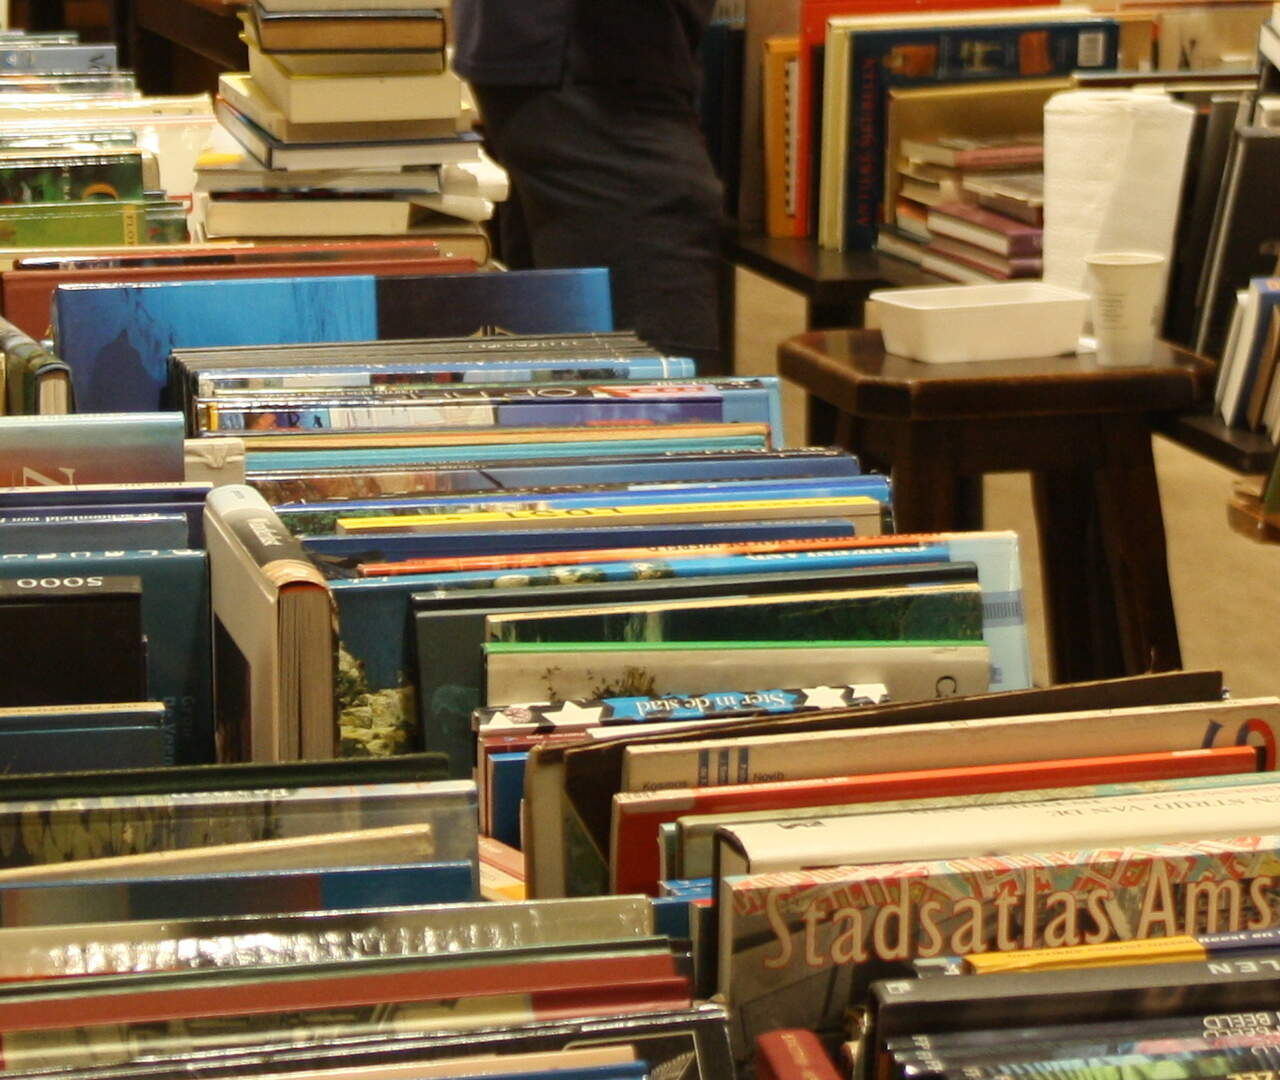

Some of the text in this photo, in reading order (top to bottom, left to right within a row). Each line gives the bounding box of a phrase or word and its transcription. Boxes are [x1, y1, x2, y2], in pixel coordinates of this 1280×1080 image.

[16, 576, 104, 589] 5000
[635, 692, 786, 716] Ster in de stad
[1090, 805, 1145, 816] VAN
[763, 865, 1115, 969] Stadsatlas
[1252, 930, 1274, 939] en
[1202, 1012, 1272, 1029] BEELD
